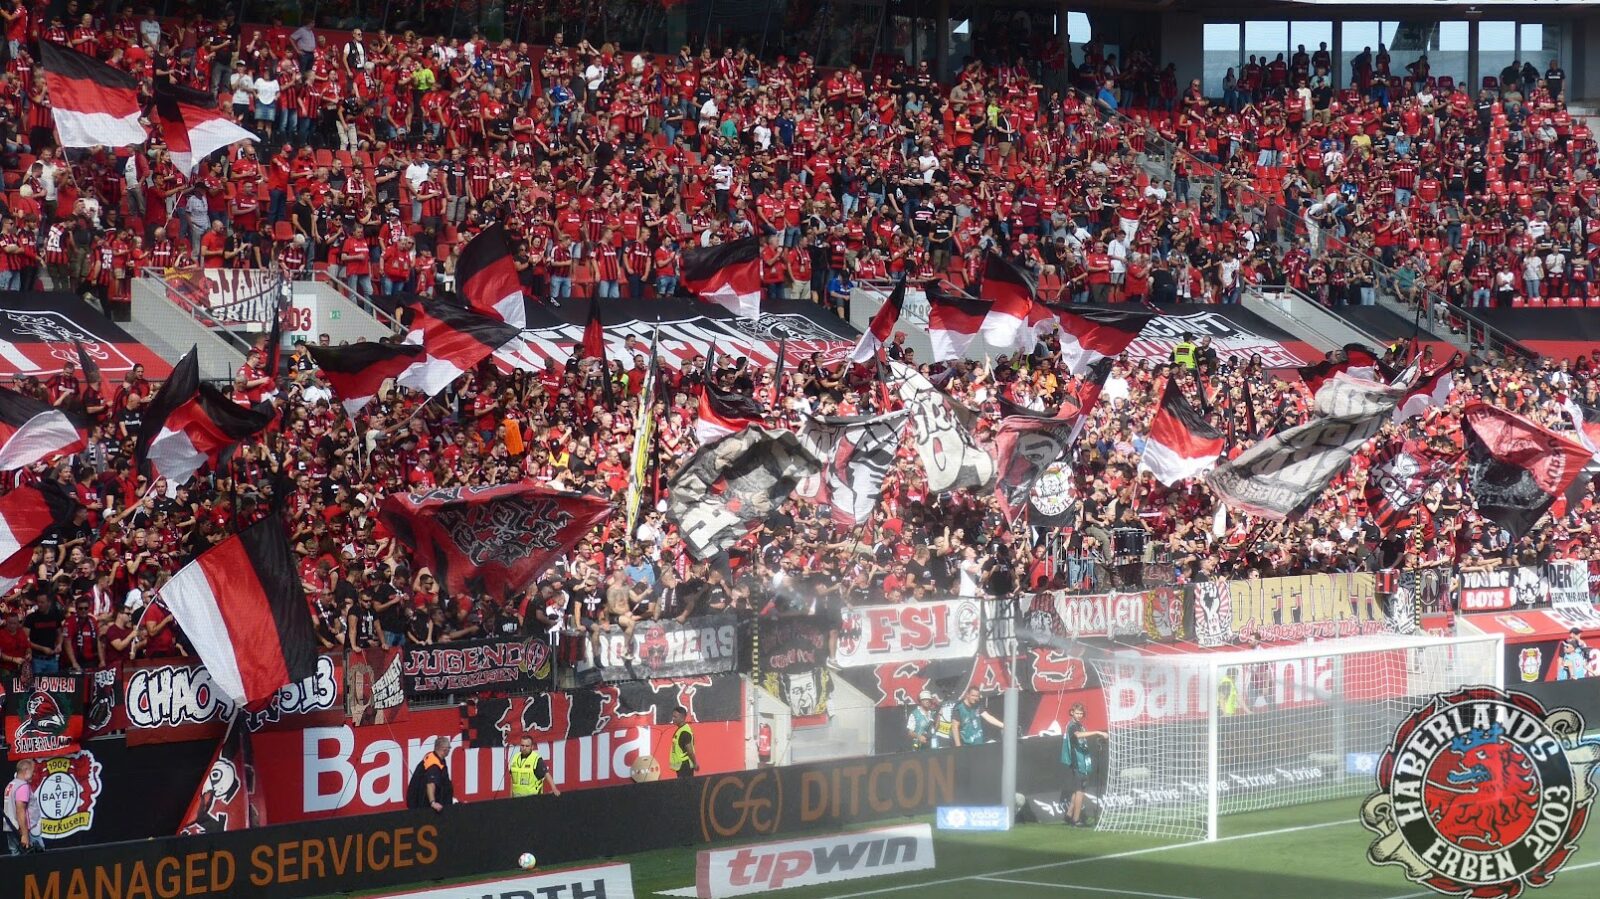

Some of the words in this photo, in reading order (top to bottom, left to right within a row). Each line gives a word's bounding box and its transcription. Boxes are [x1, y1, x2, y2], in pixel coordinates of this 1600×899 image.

[1463, 570, 1509, 588] YOUNG
[1549, 564, 1573, 588] DER
[1465, 590, 1505, 608] BOYS
[866, 604, 951, 652] FSI
[404, 642, 524, 676] JUGEND
[35, 676, 76, 693] LÖWEN
[415, 667, 519, 692] LEVERKUSEN
[1108, 650, 1336, 723] Barmnia
[48, 762, 67, 770] 1904
[303, 724, 653, 812] Barmnia
[1292, 766, 1322, 781] trive
[801, 753, 957, 823] DITCON
[1200, 779, 1229, 793] trve
[1247, 772, 1277, 787] trive
[42, 790, 75, 801] BAYER
[42, 816, 86, 832] verkusen
[24, 850, 237, 899] MANAGED
[250, 824, 439, 889] SERVICES
[727, 836, 918, 888] tipwin
